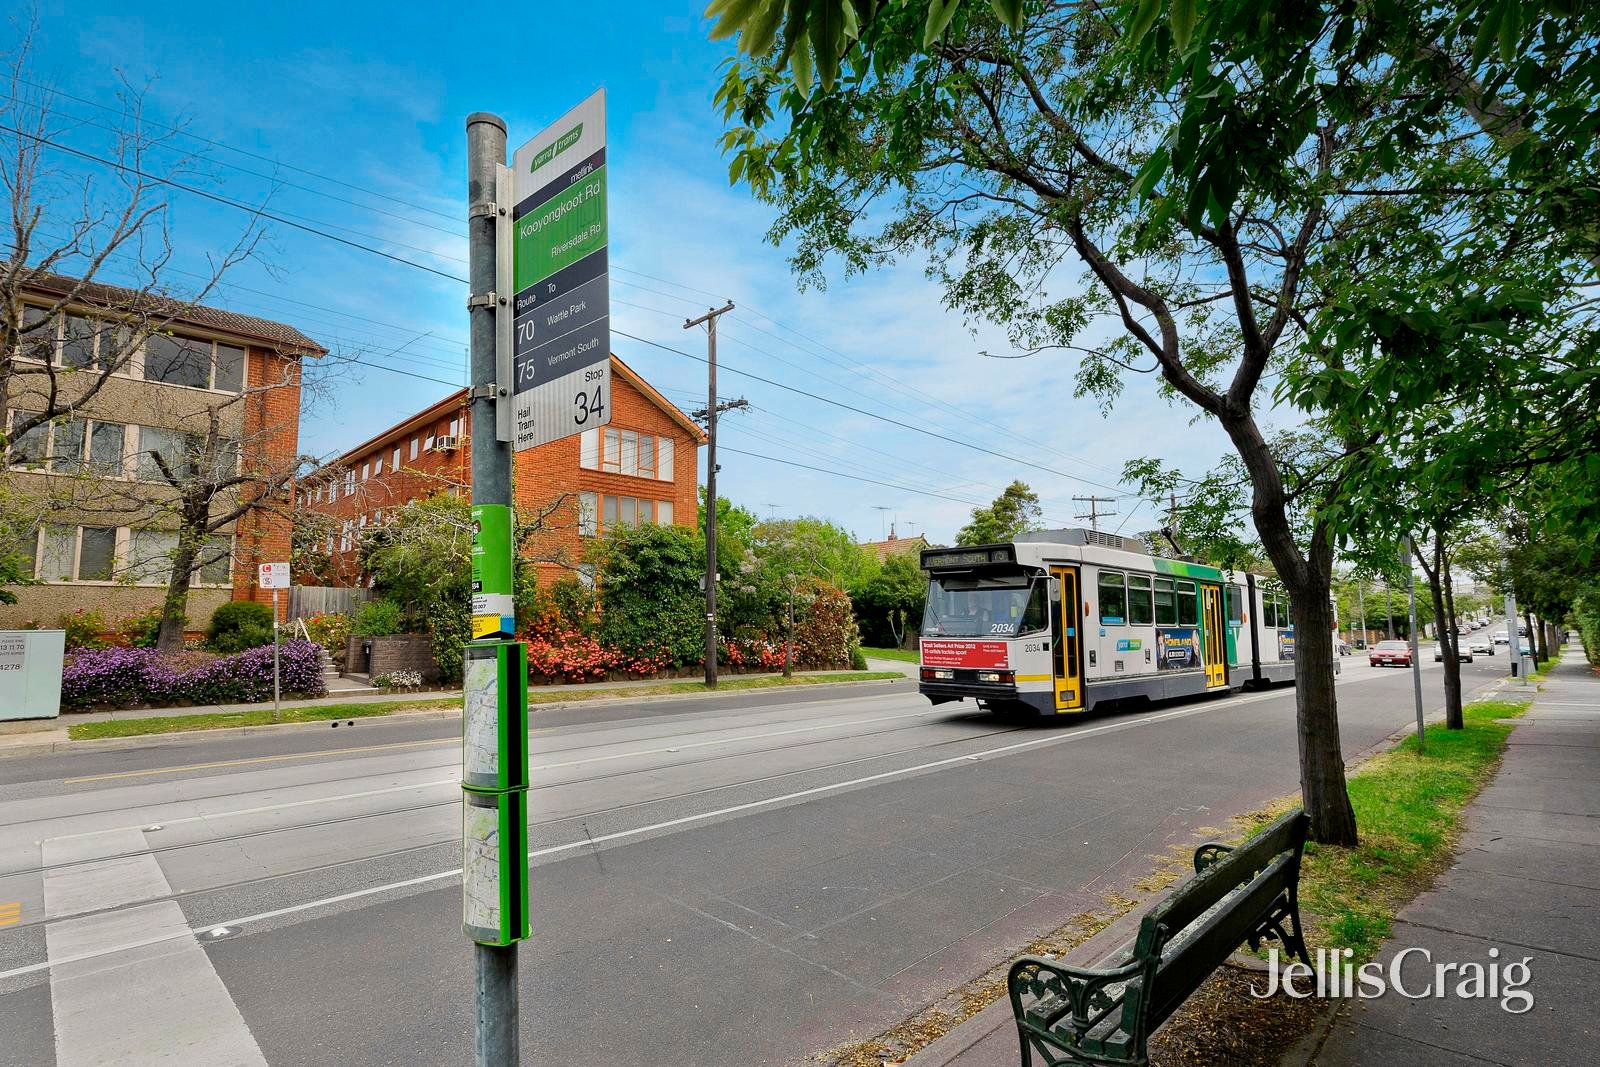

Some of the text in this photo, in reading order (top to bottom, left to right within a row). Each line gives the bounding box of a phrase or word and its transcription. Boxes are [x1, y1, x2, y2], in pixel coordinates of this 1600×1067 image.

[533, 129, 579, 169] yarra trams
[570, 162, 594, 183] metlink
[520, 179, 601, 240] Kooyongkoot Rd
[551, 221, 601, 258] Riversdale Rd
[517, 283, 556, 310] Route To
[517, 300, 587, 344] 70 Wattle Park
[517, 337, 599, 383] 75 Vermont South
[585, 369, 604, 382] Stop
[517, 406, 531, 420] Hail
[574, 384, 605, 425] 34
[517, 419, 535, 431] Tram
[517, 431, 534, 444] Here
[990, 623, 1014, 633] 2034
[1024, 644, 1041, 652] 2034
